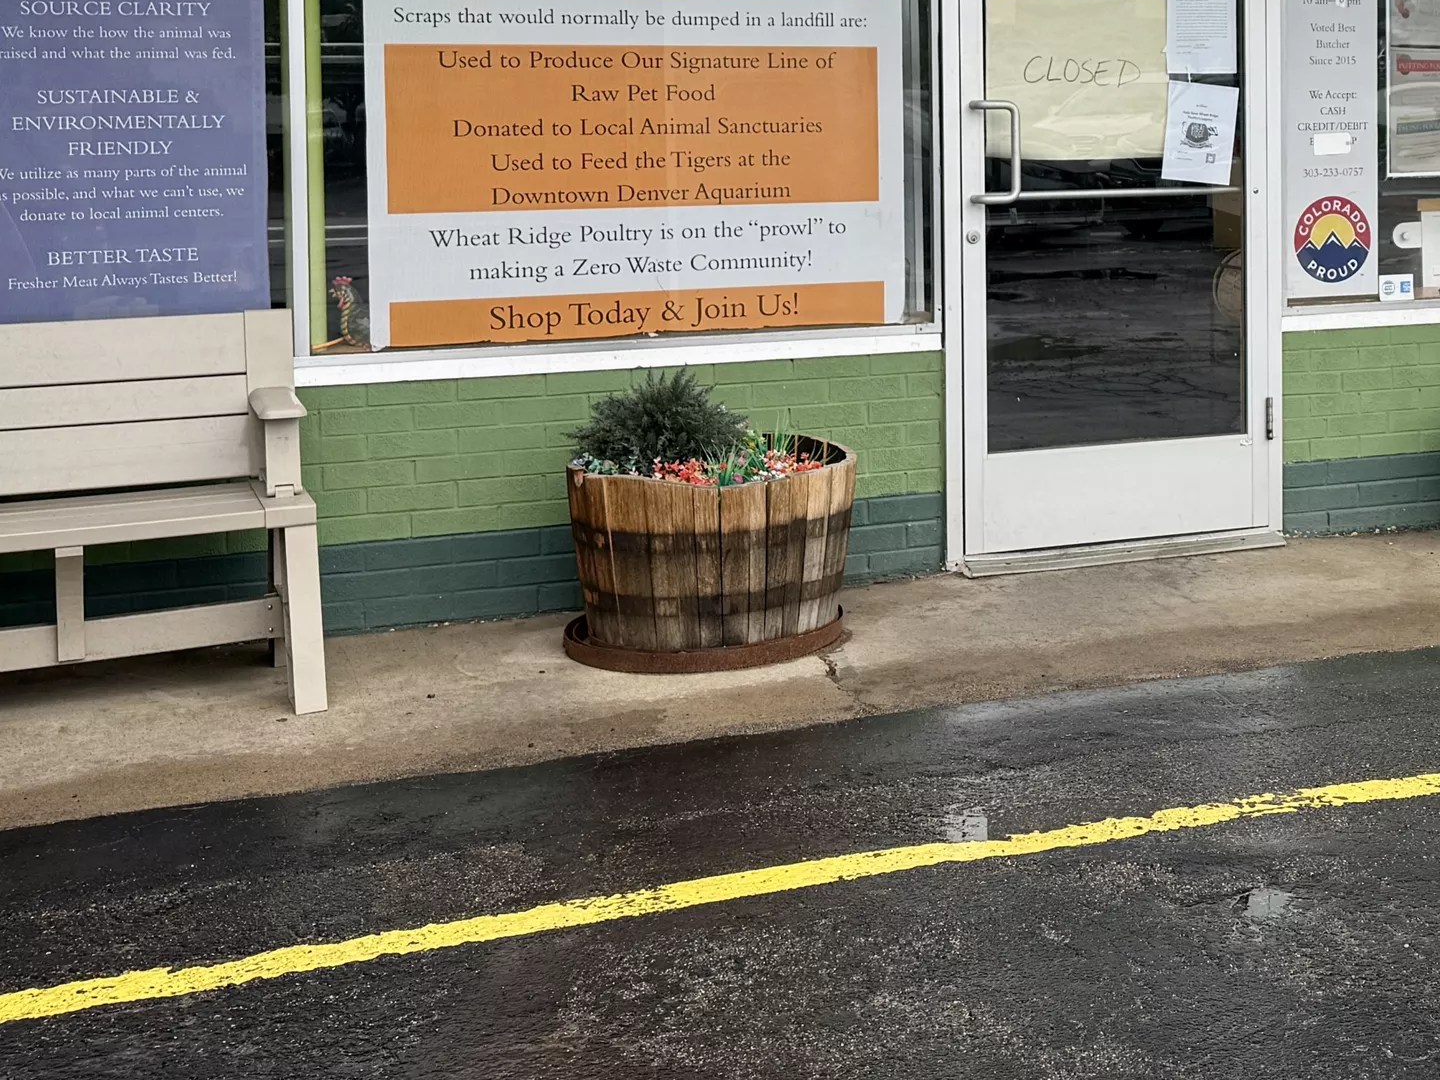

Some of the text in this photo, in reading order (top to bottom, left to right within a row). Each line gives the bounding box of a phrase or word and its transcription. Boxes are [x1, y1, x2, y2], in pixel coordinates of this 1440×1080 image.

[20, 1, 211, 16] SOURCE CLARITY
[394, 7, 867, 30] Scraps that would normally be dumped in a landfill are:
[1, 25, 231, 38] We know the how the animal was
[1310, 22, 1356, 33] Voted Best
[1316, 39, 1350, 49] Butcher
[438, 50, 837, 74] Used to Produce Our Signature Line of
[1309, 55, 1357, 66] Since 2015
[1023, 55, 1142, 88] CLOSED
[37, 89, 199, 104] SUSTAINABLE &
[572, 84, 715, 102] Raw Pet Food
[1308, 89, 1358, 102] We Accept:
[1319, 106, 1347, 116] CASH
[12, 115, 225, 130] ENVIRONMENTALLY
[453, 116, 822, 137] Donated to Local Animal Sanctuaries
[1297, 121, 1369, 131] CREDIT/DEBIT
[68, 141, 173, 156] FRIENDLY
[1303, 167, 1364, 178] 303-233-0757
[492, 182, 791, 205] Downtown Denver Aquarium
[20, 206, 224, 221] donate to local animal centers.
[1298, 199, 1367, 236] COLORADO
[48, 247, 199, 266] BETTER TASTE
[470, 250, 811, 283] making a Zero Waste Community!
[1307, 258, 1358, 280] PROUD
[8, 270, 237, 290] Fresher Meat Always Tastes Better!
[490, 292, 798, 335] Shop Today & Join Us!
